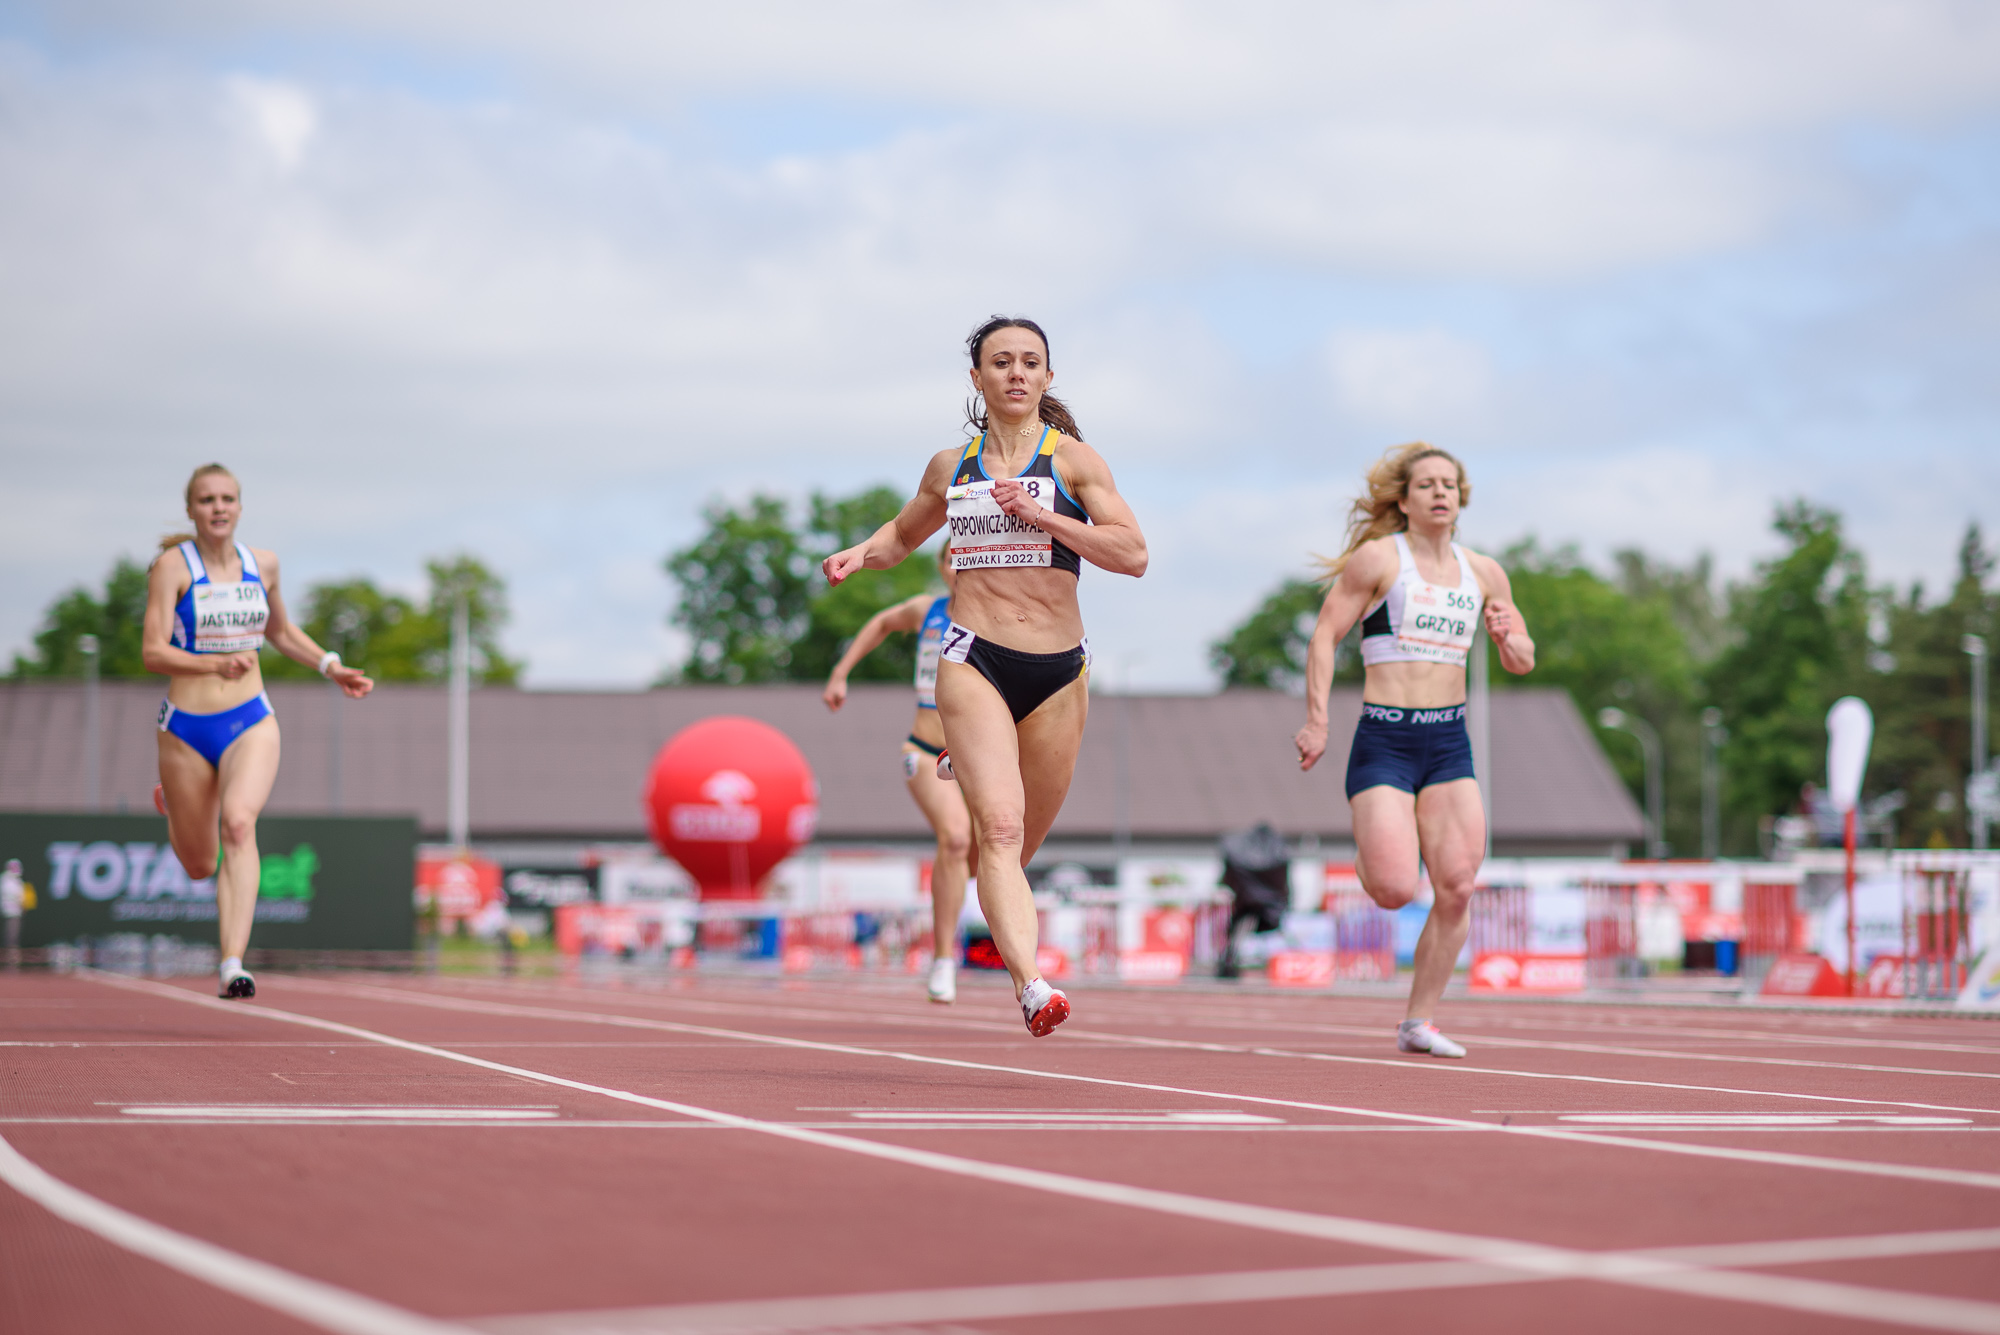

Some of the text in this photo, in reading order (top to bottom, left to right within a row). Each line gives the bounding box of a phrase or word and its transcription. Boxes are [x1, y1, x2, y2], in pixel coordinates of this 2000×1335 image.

[950, 513, 1045, 537] POPOWICZ-DRAPA
[956, 553, 1034, 567] SUWAŁKI 2022
[1447, 591, 1475, 611] 565
[1415, 613, 1466, 636] GRZYB
[943, 626, 968, 656] 7
[157, 701, 168, 724] 8
[1363, 705, 1404, 723] PRO
[1411, 708, 1454, 724] NIKE
